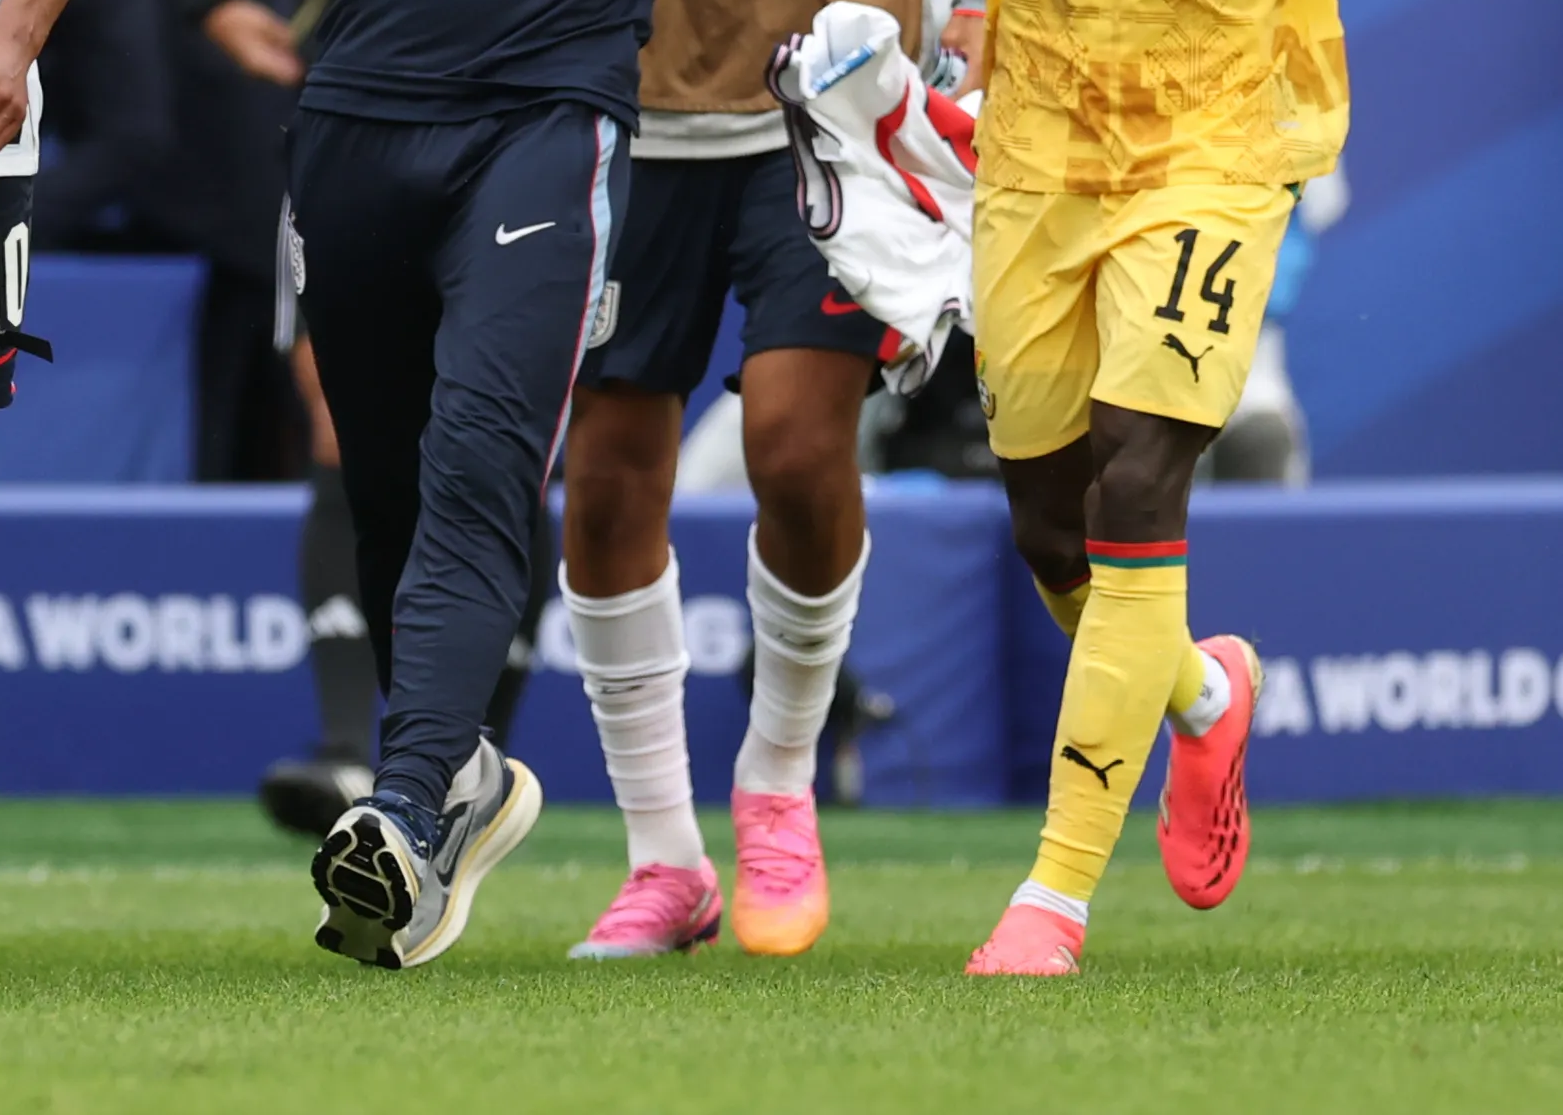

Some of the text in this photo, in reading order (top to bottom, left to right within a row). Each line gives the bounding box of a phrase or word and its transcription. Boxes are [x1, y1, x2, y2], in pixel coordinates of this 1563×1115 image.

[1154, 228, 1242, 334] 14
[26, 594, 310, 672] WORLD
[1310, 648, 1550, 733] WORLD
